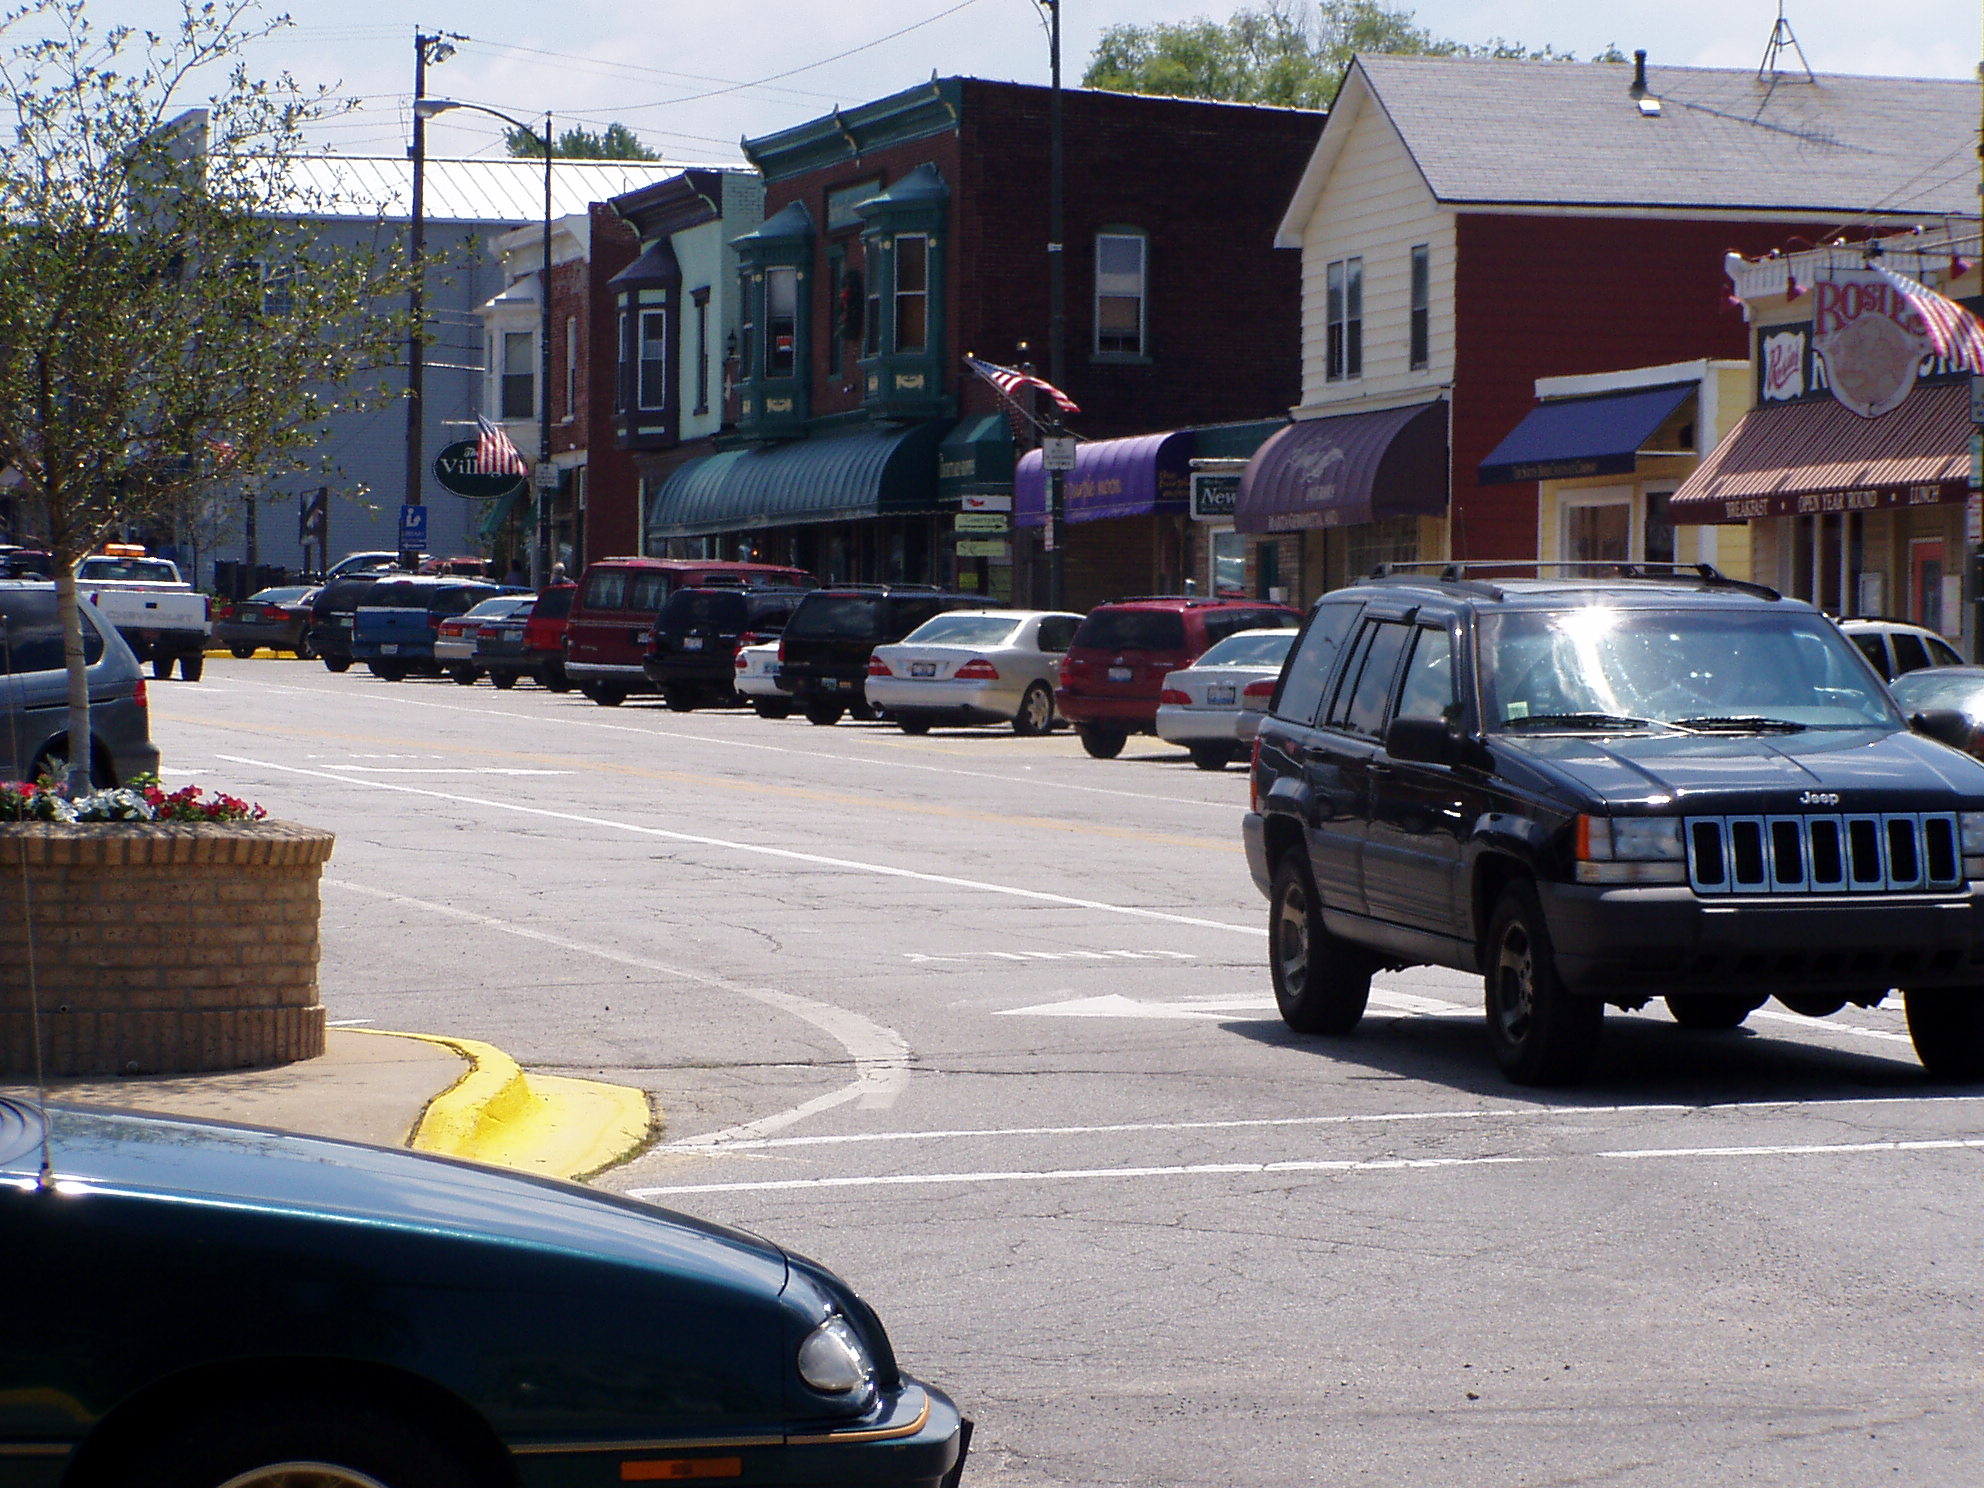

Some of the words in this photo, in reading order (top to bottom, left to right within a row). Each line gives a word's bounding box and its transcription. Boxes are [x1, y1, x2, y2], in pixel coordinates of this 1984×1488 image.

[1725, 498, 1768, 518] BREAKFAST
[1799, 495, 1819, 512] OPEN
[1822, 493, 1844, 510] YEAR
[1848, 490, 1877, 508] ROUND
[1909, 485, 1940, 504] LUNCH
[1799, 791, 1840, 806] Jeep
